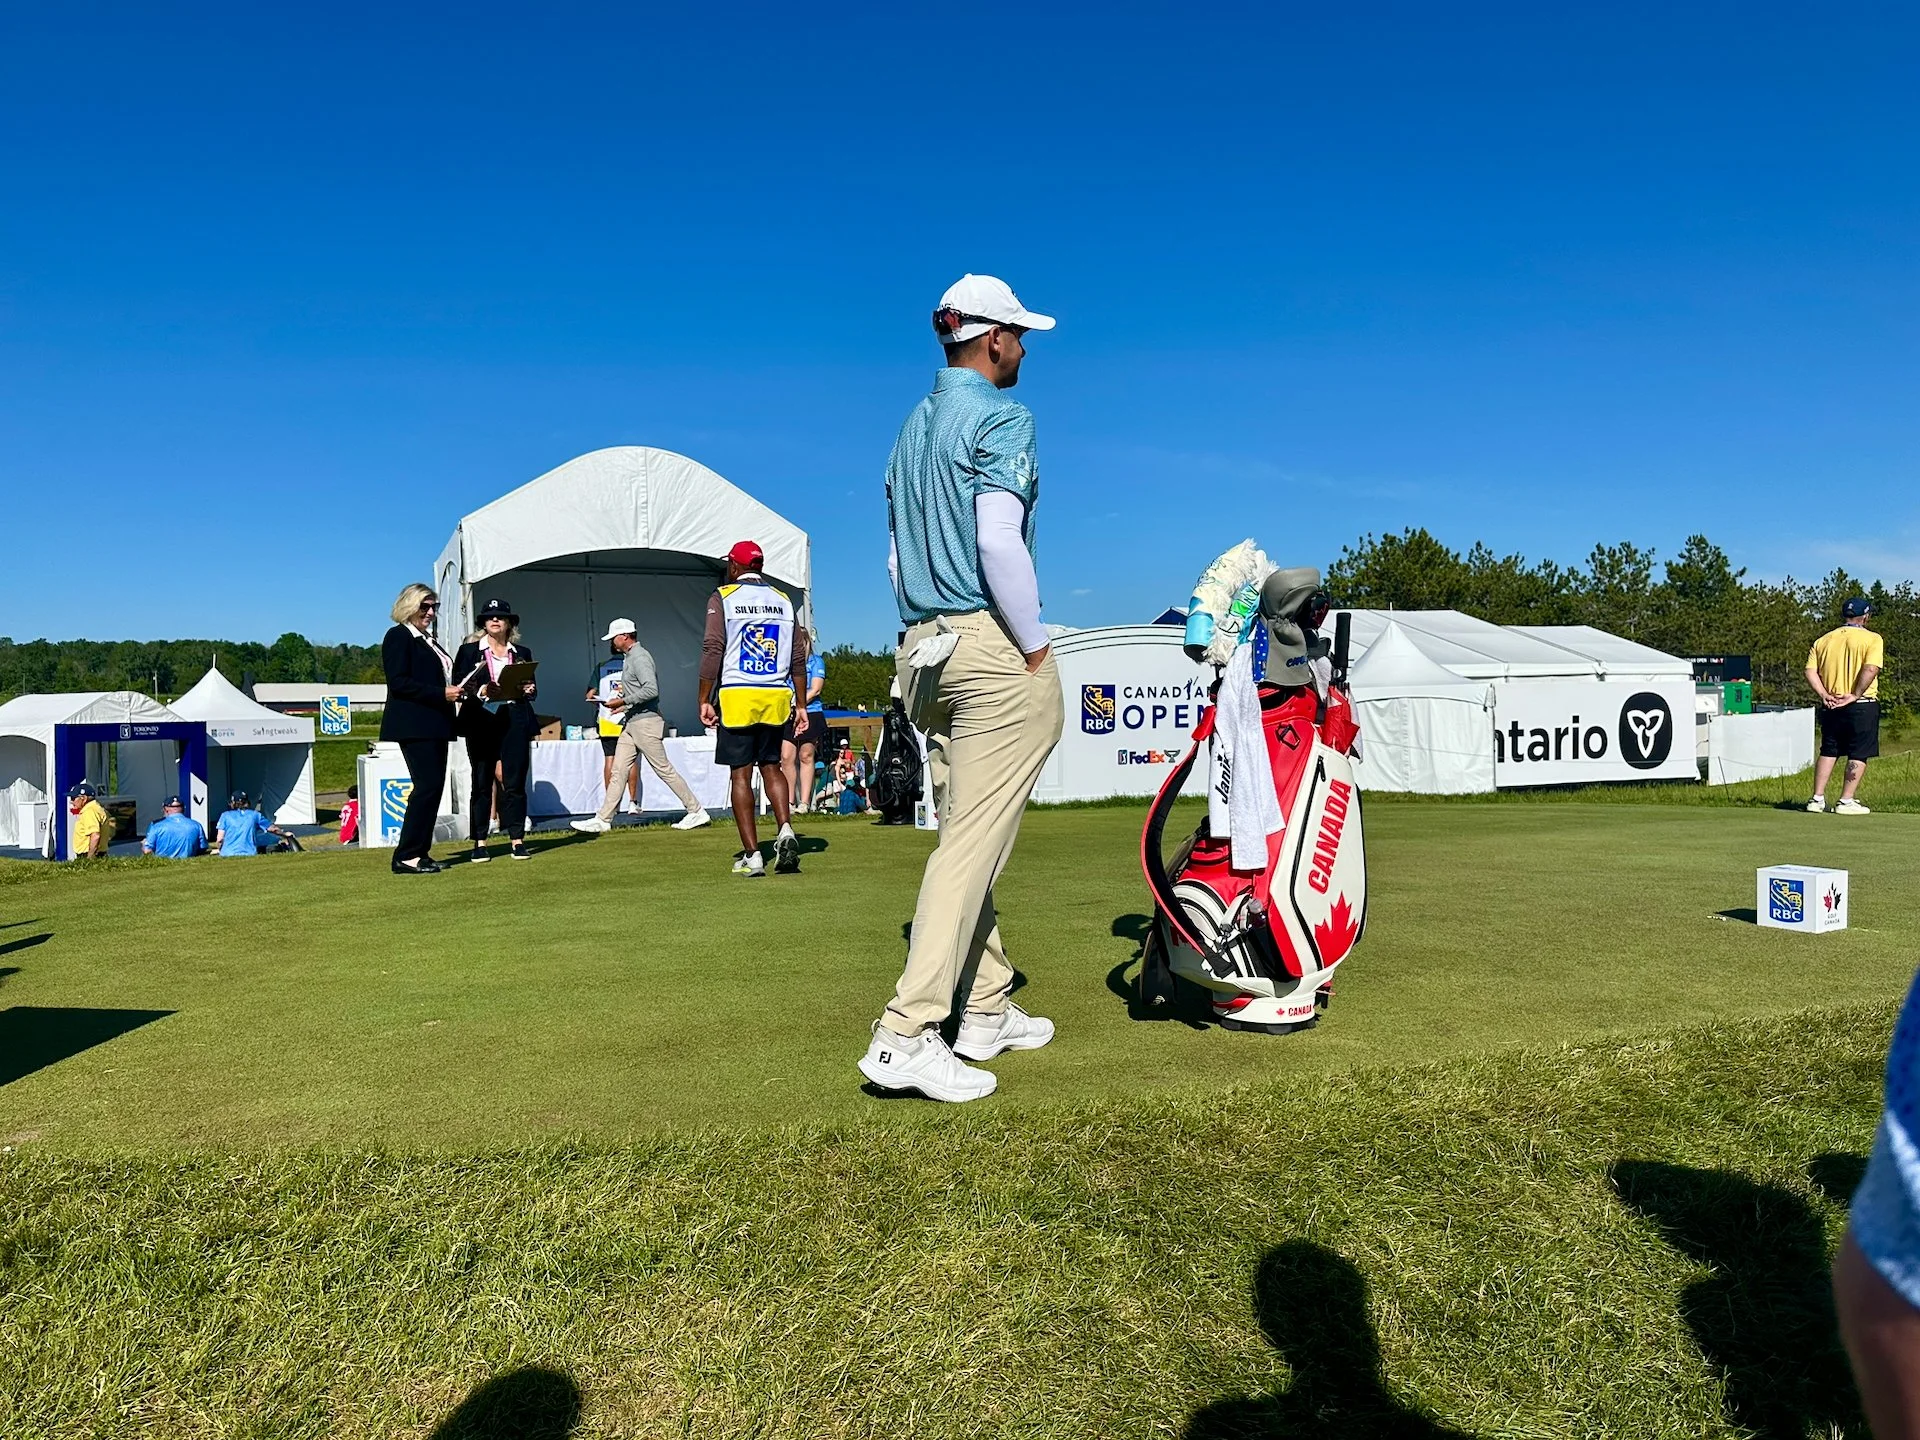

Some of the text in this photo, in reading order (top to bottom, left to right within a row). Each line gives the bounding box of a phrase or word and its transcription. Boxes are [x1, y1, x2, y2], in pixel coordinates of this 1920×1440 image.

[735, 605, 783, 615] SILVERMAN
[743, 660, 775, 672] RBC
[324, 721, 348, 732] RBC
[1086, 718, 1113, 730] RBC
[252, 727, 298, 736] Swingtweaks
[1129, 750, 1165, 764] FedEx
[1308, 778, 1352, 895] CANADA
[1772, 908, 1801, 921] RBC
[879, 1051, 892, 1064] FJ
